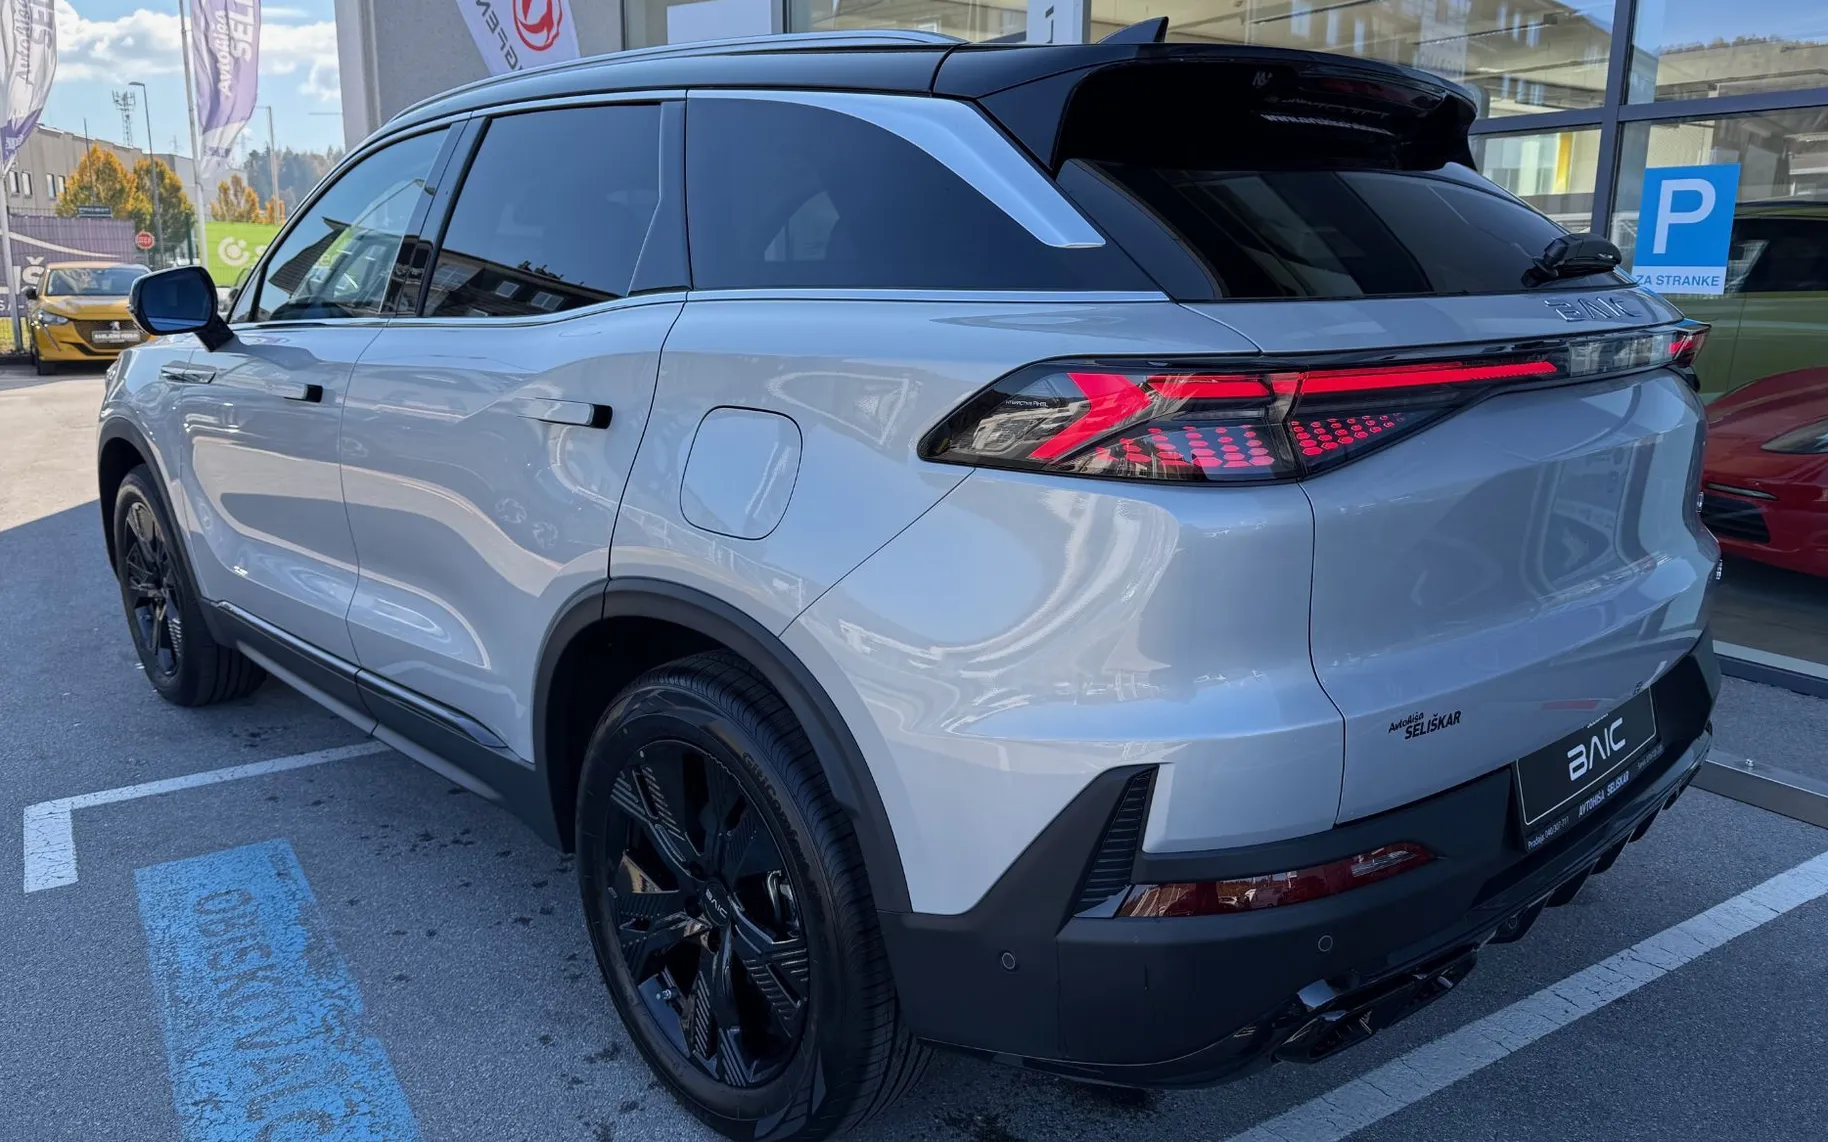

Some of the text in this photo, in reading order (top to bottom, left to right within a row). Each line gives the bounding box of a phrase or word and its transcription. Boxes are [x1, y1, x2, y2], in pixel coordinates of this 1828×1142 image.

[1652, 178, 1717, 255] P
[1636, 275, 1720, 287] ZA STRANKE
[1544, 297, 1642, 322] BAIC
[1404, 711, 1462, 740] SELIŠKAR
[1567, 717, 1627, 781] BAIC
[705, 888, 728, 919] BAIC
